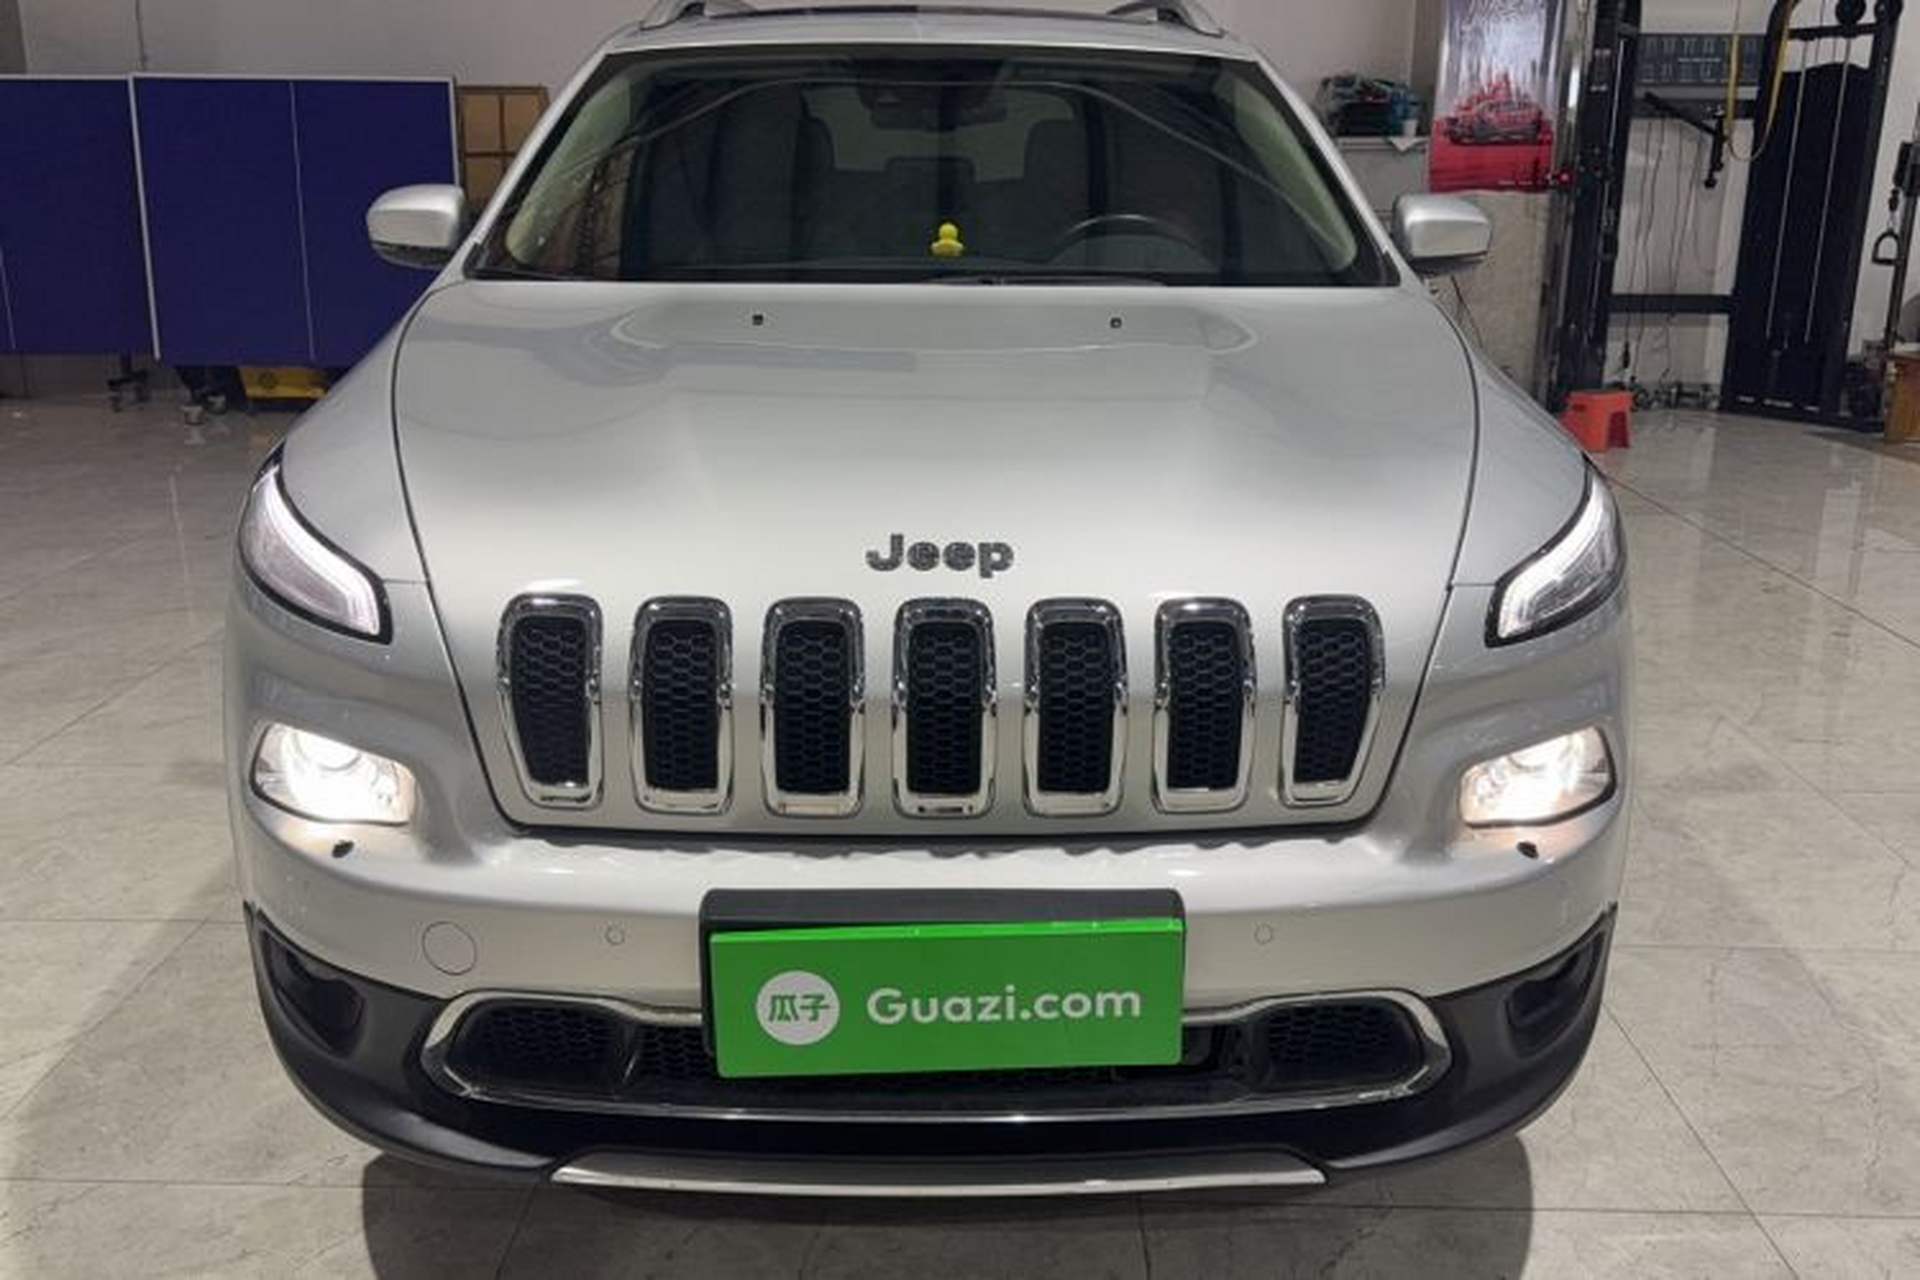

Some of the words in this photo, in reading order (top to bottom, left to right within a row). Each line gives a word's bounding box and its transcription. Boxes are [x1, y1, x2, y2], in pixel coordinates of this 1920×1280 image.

[865, 533, 1014, 579] Jeep
[768, 993, 830, 1022] 瓜子
[866, 985, 1142, 1024] Guazi.com
